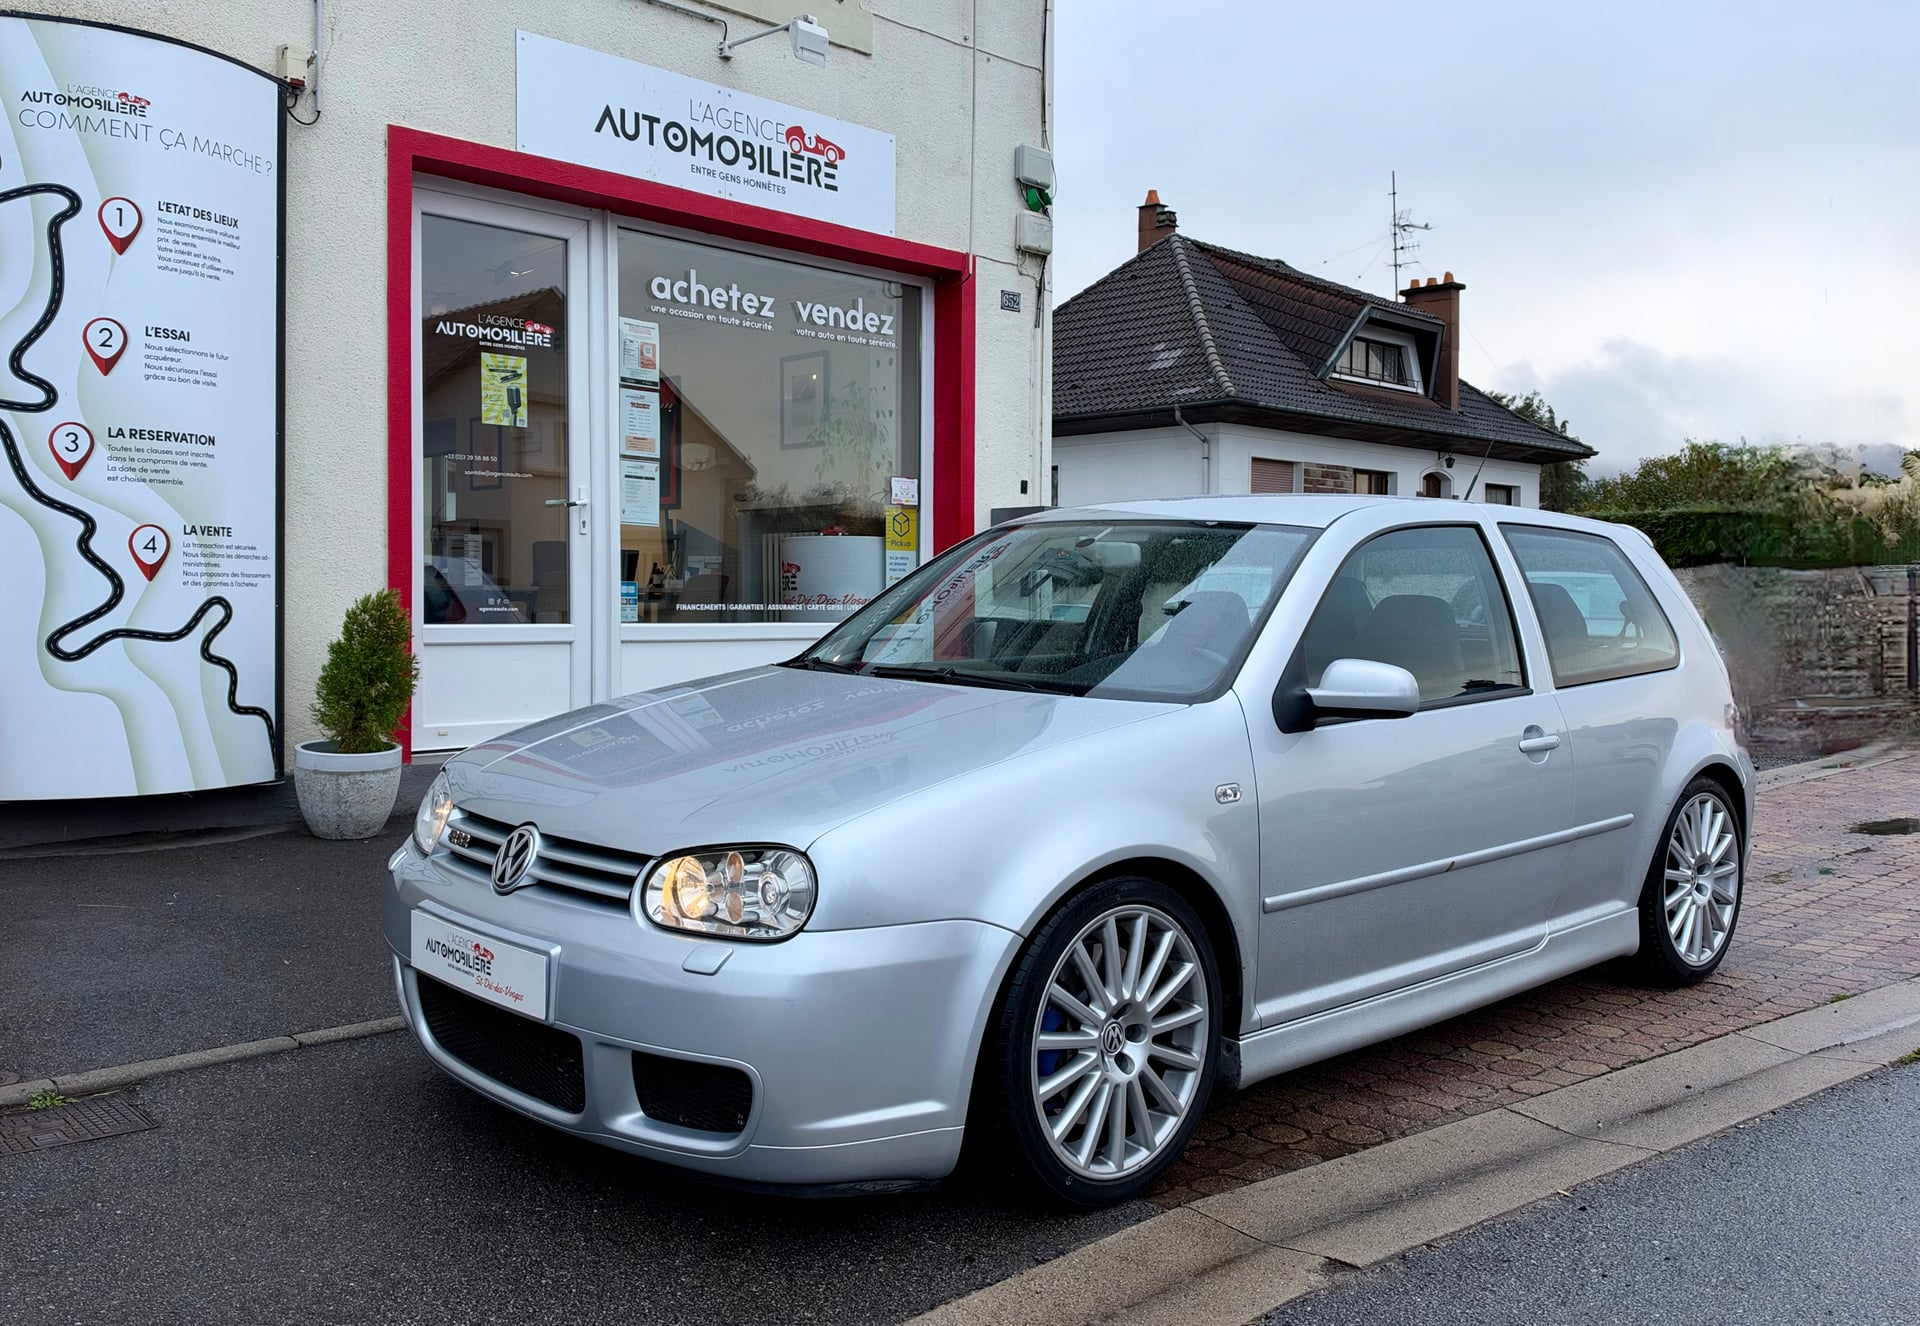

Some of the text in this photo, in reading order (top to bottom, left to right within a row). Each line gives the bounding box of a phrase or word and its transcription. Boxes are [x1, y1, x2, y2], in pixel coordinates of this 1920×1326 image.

[67, 84, 118, 99] L'AGENCE
[690, 99, 785, 144] L'AGENCE
[19, 108, 153, 141] COMMENT
[160, 128, 187, 150] ÇA
[193, 136, 262, 174] MARCHE
[691, 164, 786, 195] ENTRE GENS HONNÊTES
[116, 207, 124, 227] 1
[158, 201, 239, 229] L'ETAT DES LIEUX
[157, 217, 173, 225] Nous
[174, 221, 204, 232] examinons
[173, 228, 190, 238] fixons
[157, 245, 173, 253] Votre
[157, 254, 172, 262] Vous
[651, 268, 775, 318] achetez
[1003, 294, 1019, 309] 652
[478, 313, 525, 329] L'AGENCE
[650, 305, 666, 314] une
[669, 308, 704, 320] occasion
[706, 314, 716, 322] en
[719, 315, 740, 326] toute
[796, 298, 894, 335] vendez
[99, 327, 113, 347] 2
[145, 326, 190, 342] L'ESSAI
[796, 328, 816, 337] votre
[818, 331, 834, 339] auto
[848, 335, 866, 345] toute
[144, 343, 163, 351] Nous
[144, 362, 163, 371] Nous
[164, 365, 199, 376] sécurisons
[178, 376, 191, 384] bon
[64, 432, 79, 452] 3
[108, 427, 216, 446] LA RESERVATION
[107, 444, 132, 453] Toutes
[146, 447, 173, 456] clauses
[174, 449, 189, 457] sont
[190, 451, 215, 459] inscrites
[107, 454, 126, 462] dans
[128, 455, 136, 463] le
[137, 457, 178, 466] compromis
[179, 458, 189, 466] de
[107, 464, 117, 472] La
[118, 465, 136, 473] date
[120, 475, 147, 483] choisie
[183, 524, 232, 537] LA VENTE
[143, 535, 157, 554] 4
[192, 542, 225, 550] transaction
[891, 539, 911, 548] Pickup
[200, 571, 230, 579] proposons
[676, 603, 726, 611] FINANCEMENTS
[729, 603, 764, 611] GARANTIES
